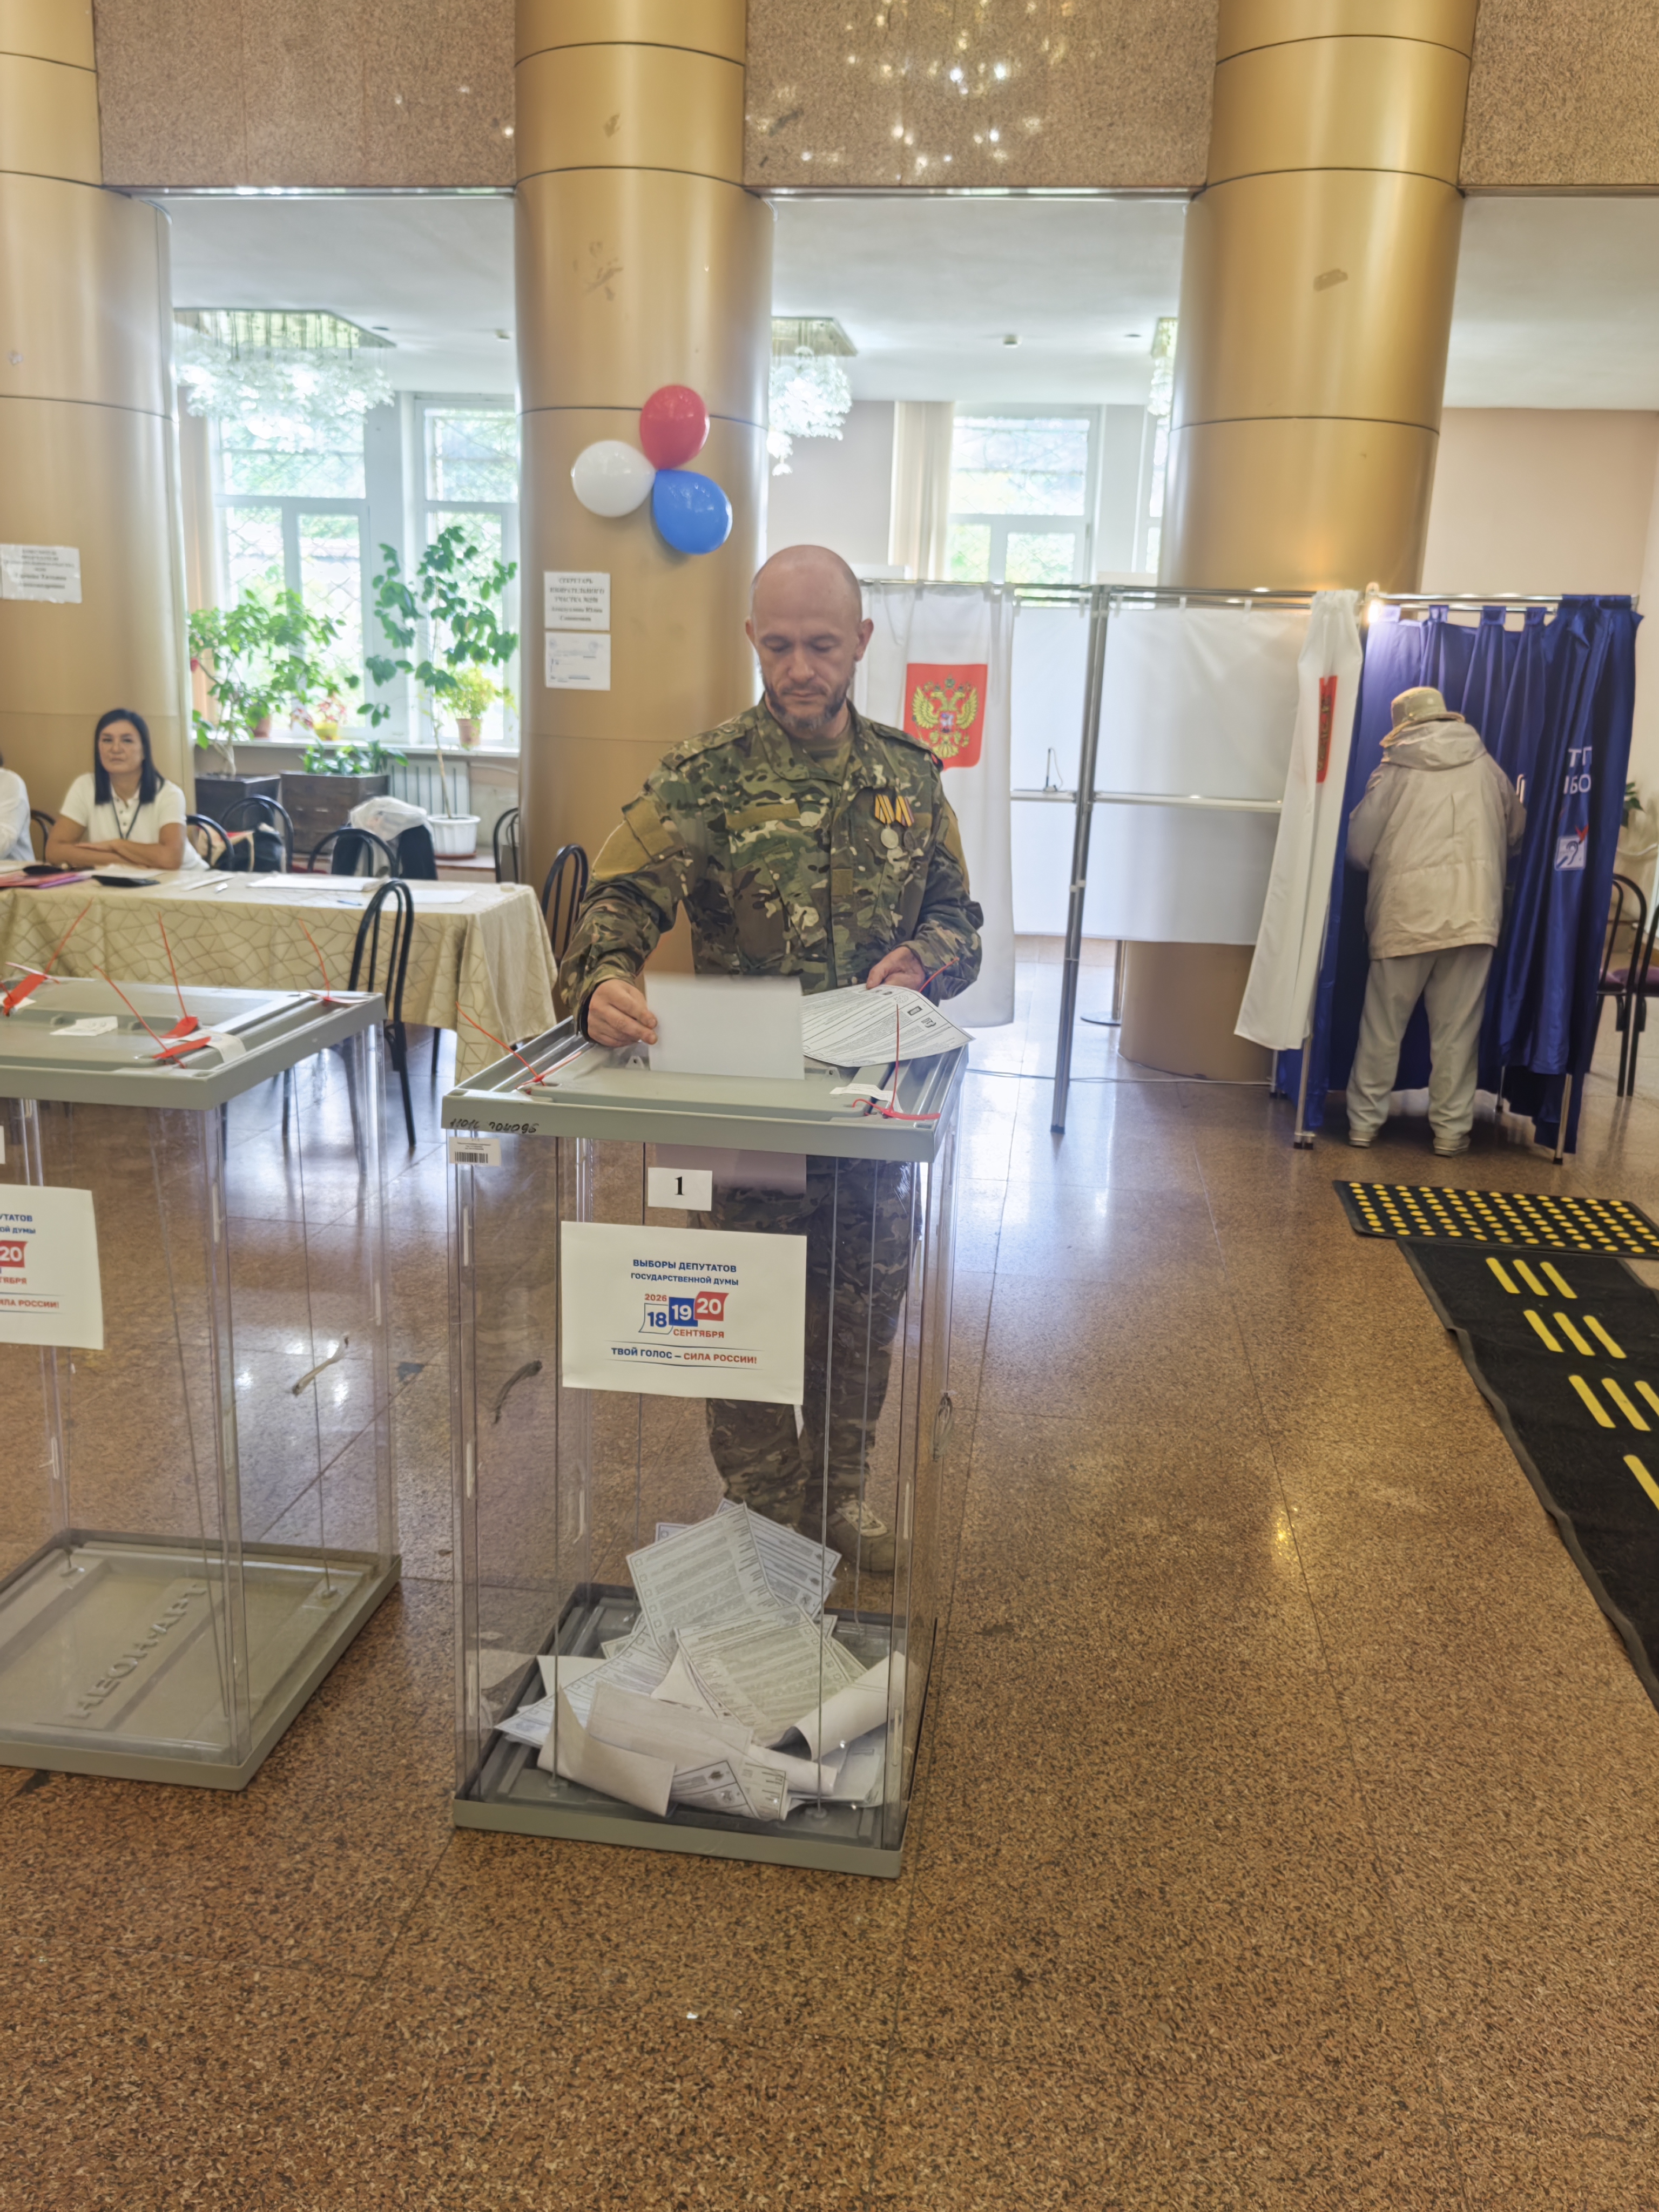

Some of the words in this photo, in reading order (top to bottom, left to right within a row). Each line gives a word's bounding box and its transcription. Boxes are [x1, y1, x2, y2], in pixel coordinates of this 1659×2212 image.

[674, 1175, 685, 1196] 1
[0, 1246, 23, 1262] 20
[632, 1259, 677, 1270] ВЫБОРЫ
[678, 1262, 737, 1273] ДЕПУТАТОВ
[631, 1272, 712, 1285] ГОСУДАРСТВЕННОЙ
[713, 1277, 739, 1286] ДУМЫ
[18, 1299, 59, 1309] РОССИИ!
[644, 1293, 667, 1303] 2026
[647, 1312, 667, 1328] 18
[671, 1304, 692, 1321] 19
[696, 1298, 722, 1316] 20
[673, 1328, 725, 1339] СЕНТЯБРЯ
[611, 1346, 638, 1357] ТВОЙ
[640, 1349, 673, 1360] ГОЛОС
[683, 1352, 711, 1361] СИЛА
[713, 1354, 757, 1365] РОССИИ!
